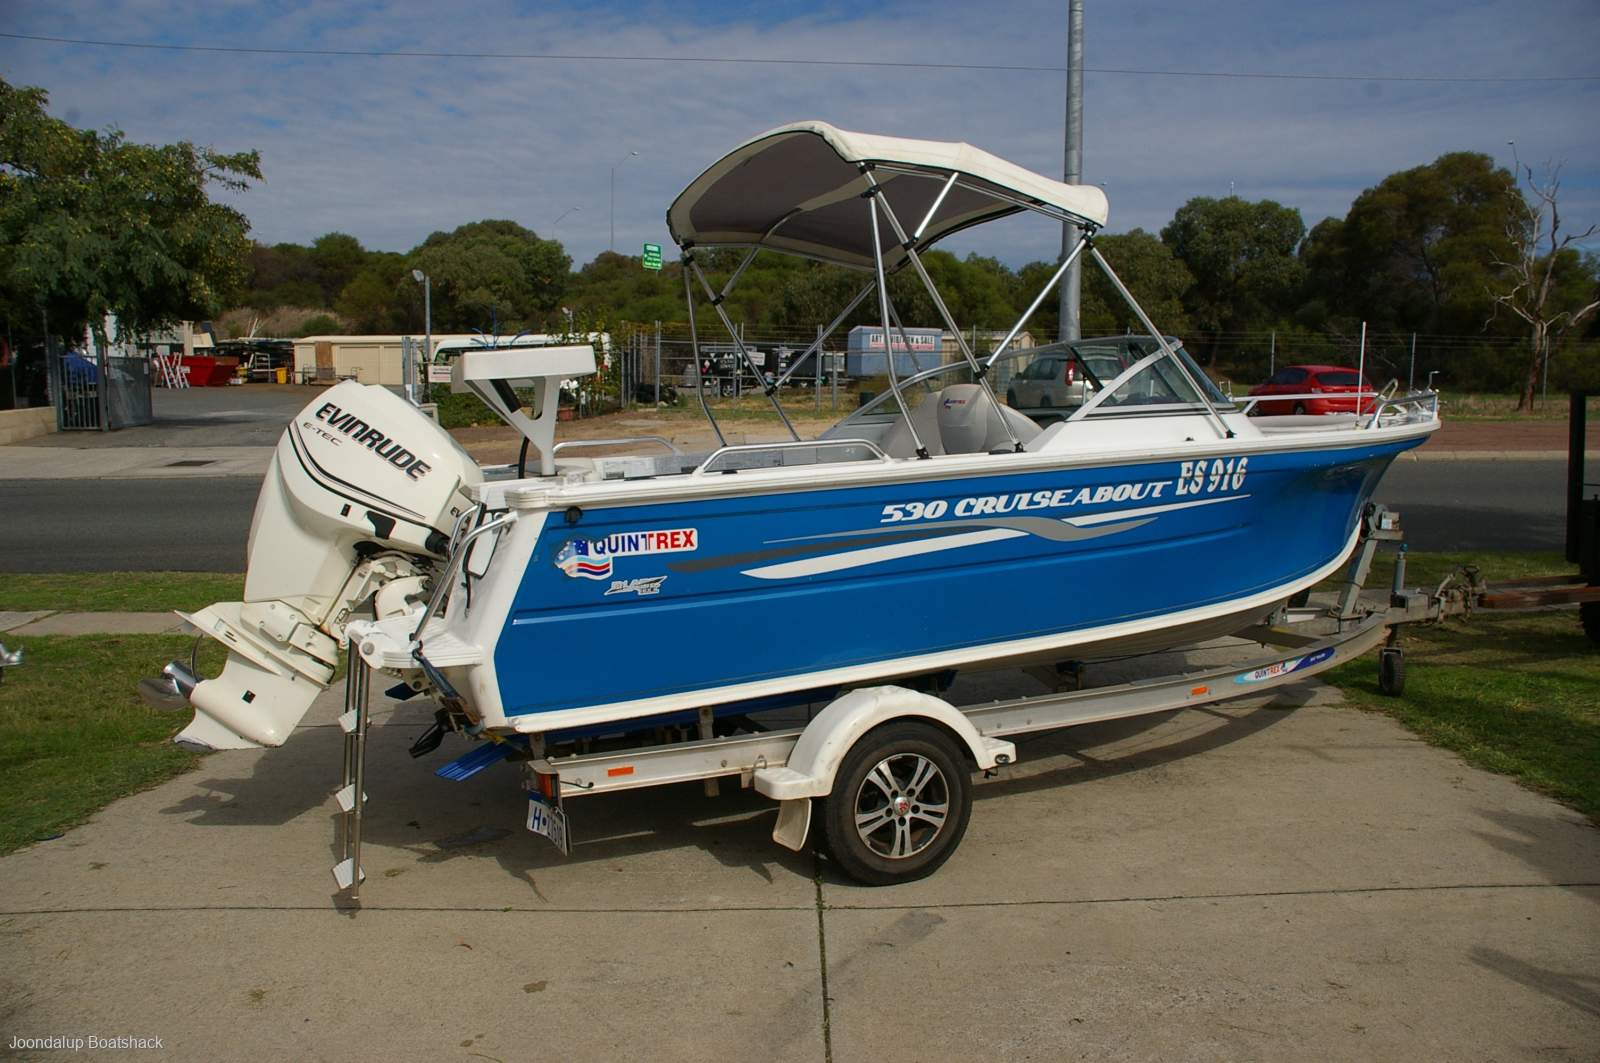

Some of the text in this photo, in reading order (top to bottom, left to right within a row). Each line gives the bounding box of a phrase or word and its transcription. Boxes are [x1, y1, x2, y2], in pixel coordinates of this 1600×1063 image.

[303, 422, 342, 446] E-TEC
[315, 402, 432, 481] EVINRUDE
[1175, 457, 1249, 496] ES 916
[954, 480, 1173, 518] CRUISEABOUT
[594, 529, 695, 555] QUINTREX
